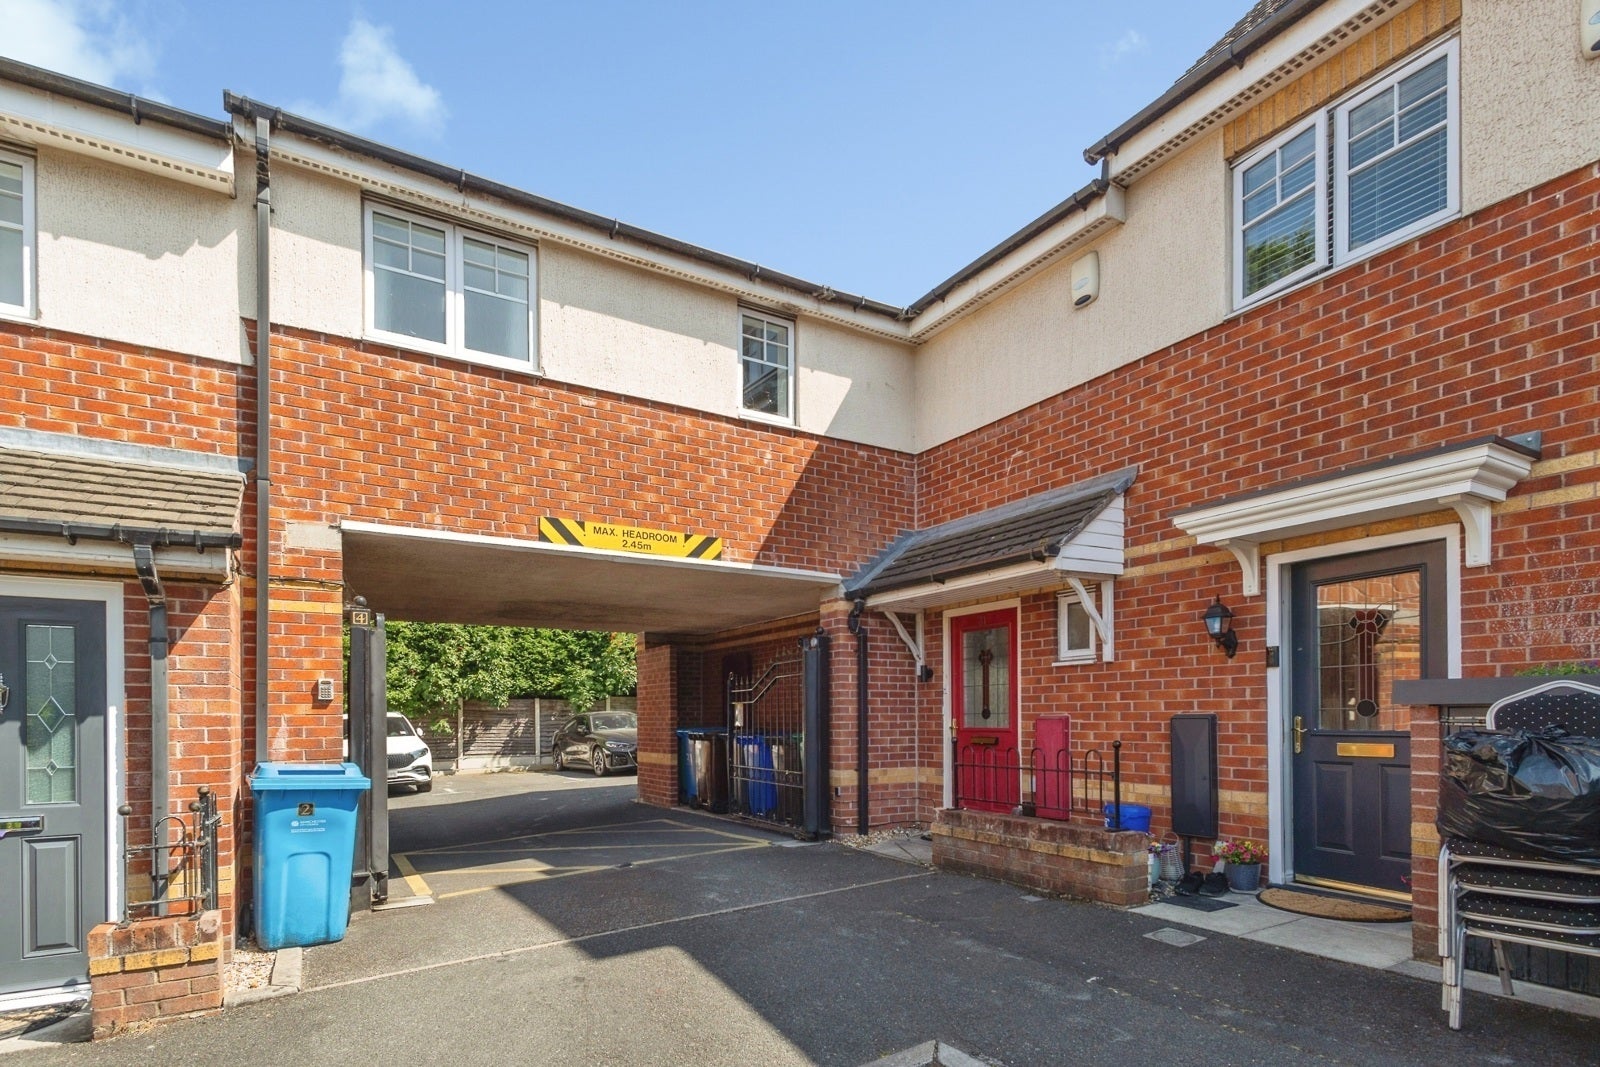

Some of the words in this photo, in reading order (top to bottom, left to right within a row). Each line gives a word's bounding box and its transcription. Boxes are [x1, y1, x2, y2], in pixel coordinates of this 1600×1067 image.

[593, 526, 618, 537] MAX.
[622, 530, 677, 543] HEADROOM
[622, 539, 652, 550] 2.45m
[355, 613, 366, 624] 4
[301, 804, 311, 815] 2
